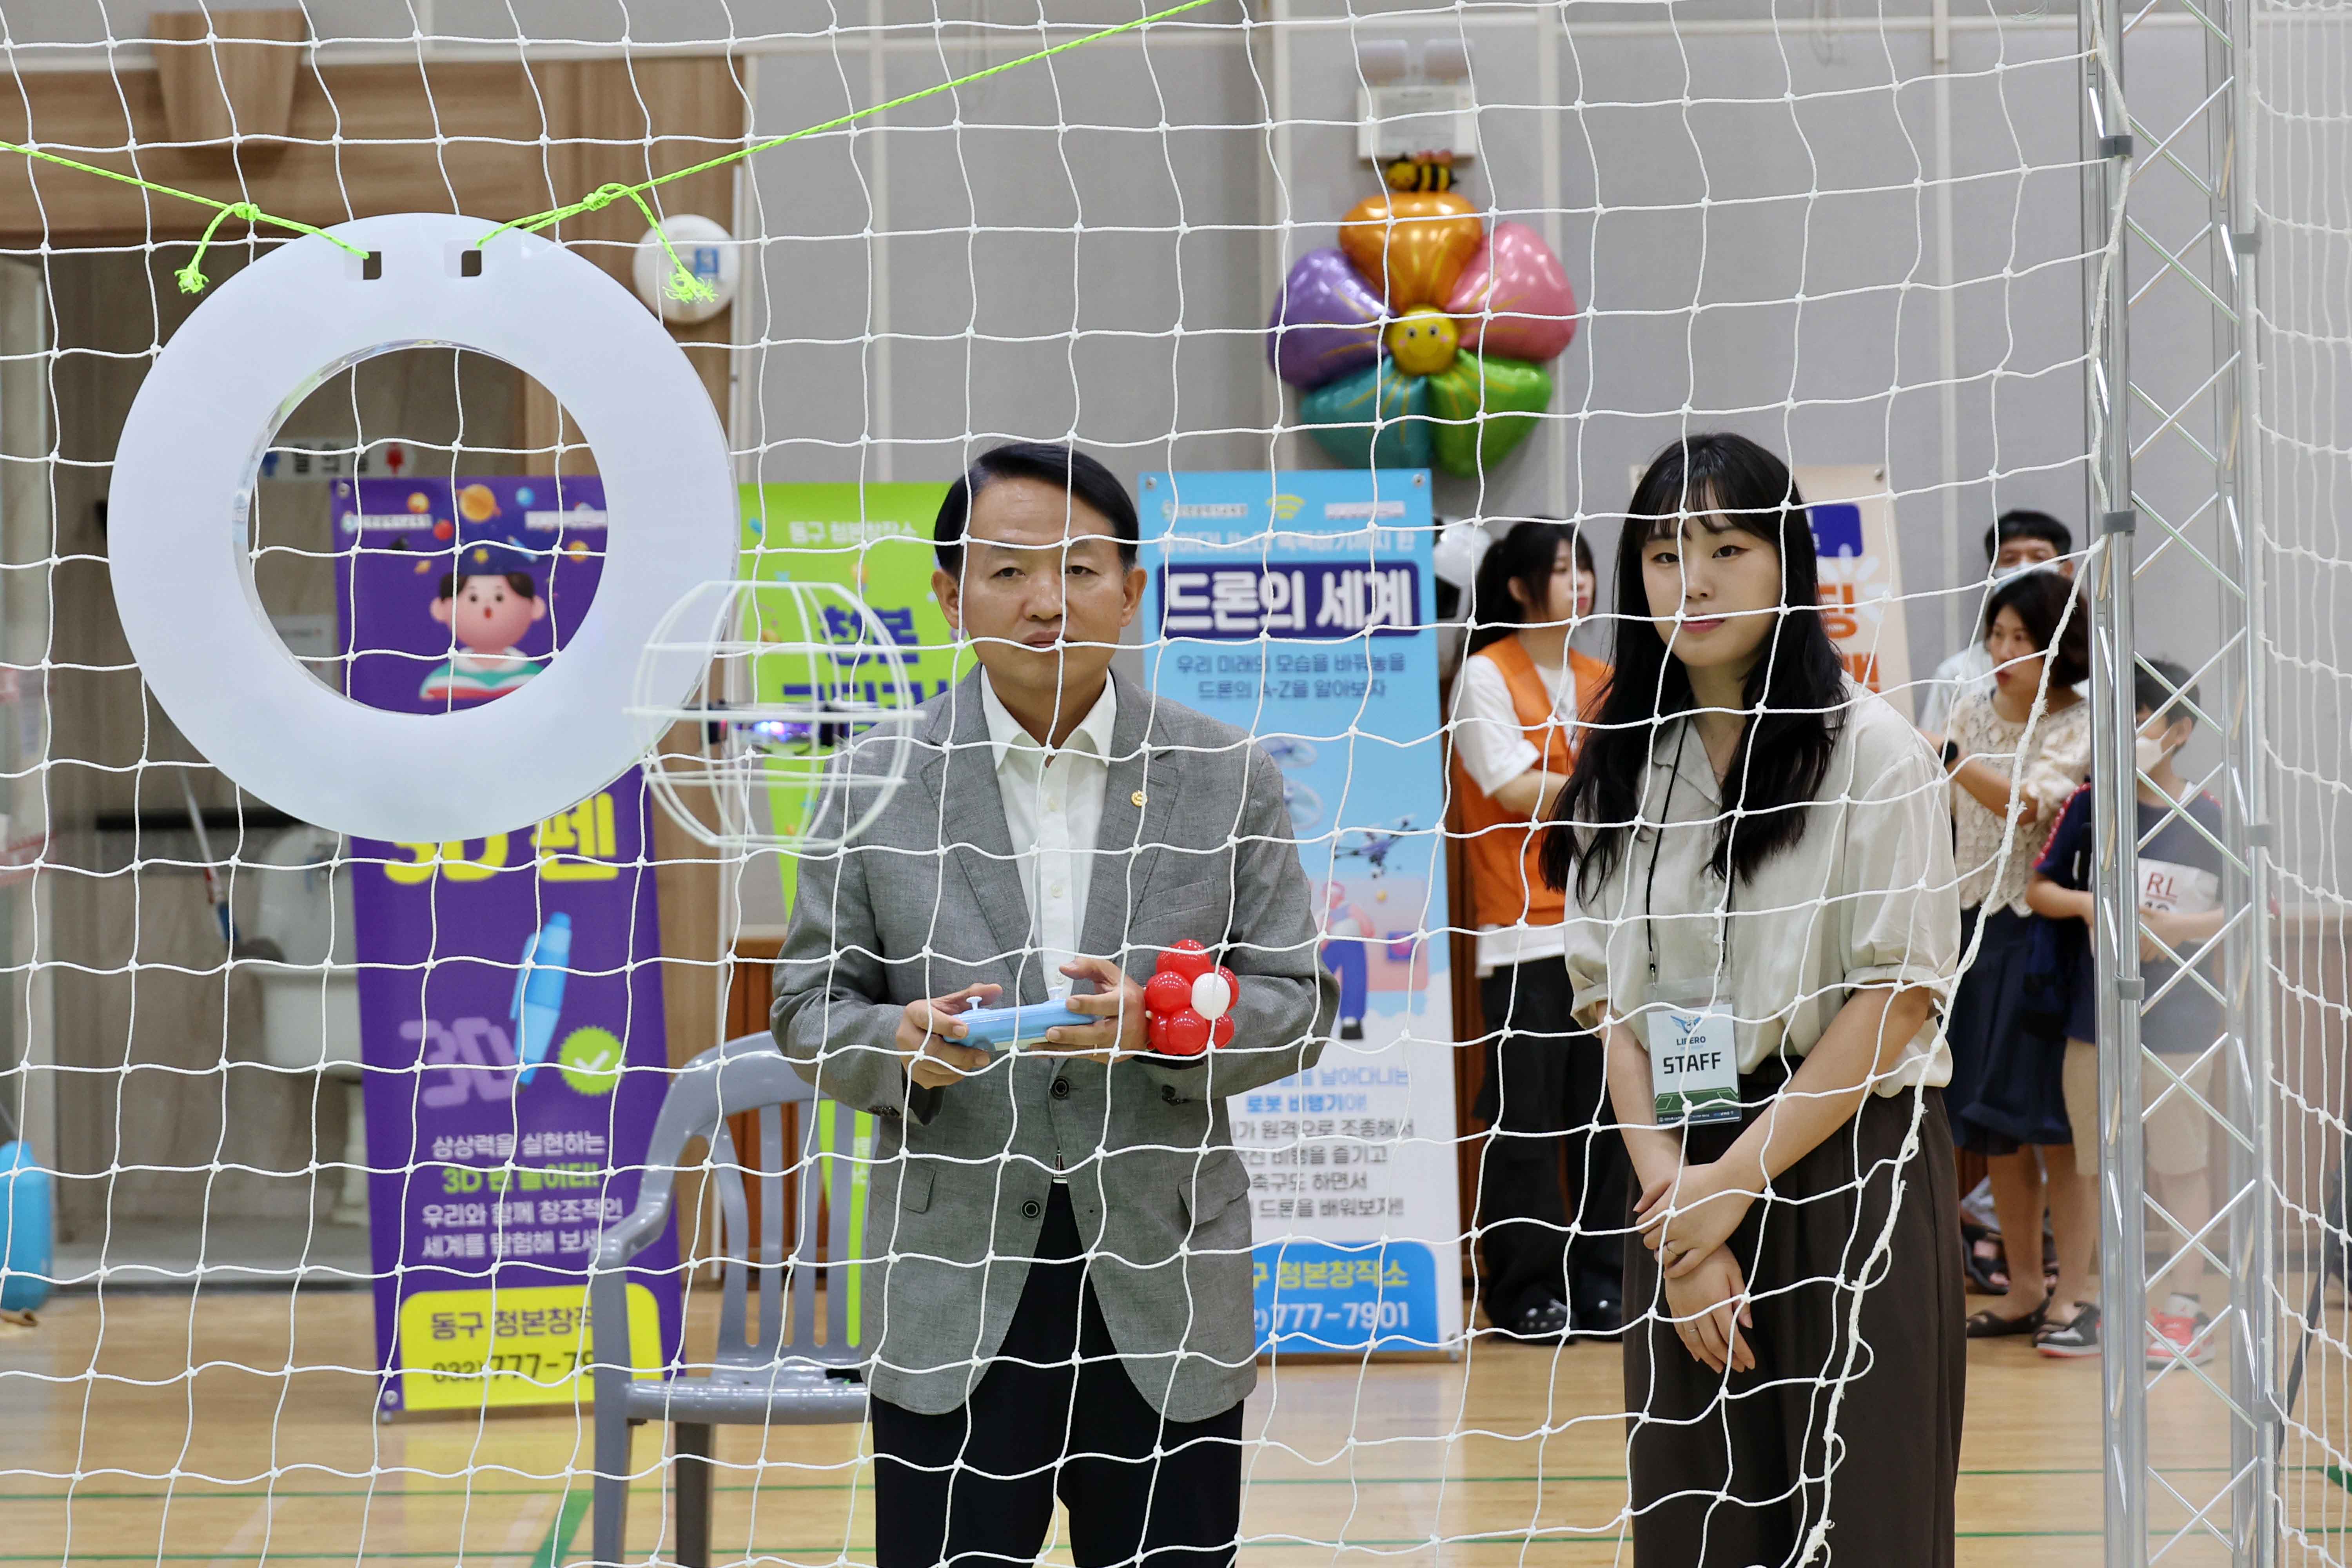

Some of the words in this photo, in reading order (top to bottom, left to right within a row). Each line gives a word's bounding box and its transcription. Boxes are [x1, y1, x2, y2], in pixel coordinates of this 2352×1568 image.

[1167, 569, 1306, 631] 드론의
[1316, 568, 1412, 630] 세계
[1177, 655, 1211, 674] 우리
[1218, 655, 1271, 673] 미래의
[1277, 654, 1328, 673] 모습을
[1199, 681, 1252, 700] 드론의
[1315, 680, 1387, 699] 알아보자
[530, 792, 619, 882] 펜
[1664, 1052, 1721, 1074] STAFF
[1262, 1120, 1333, 1138] 원격으로
[1341, 1118, 1414, 1136] 조종해서
[432, 1134, 514, 1160] 상상력을
[521, 1131, 605, 1158] 실현하는
[1333, 1145, 1387, 1164] 즐기고
[442, 1167, 482, 1194] 3D
[1252, 1173, 1306, 1191] 축구도
[1312, 1172, 1368, 1190] 하면서
[422, 1203, 486, 1228] 우리와
[491, 1201, 534, 1225] 함께
[539, 1198, 624, 1224] 창조적인
[1259, 1199, 1313, 1218] 드론을
[422, 1235, 486, 1259] 세계를
[431, 1311, 483, 1340] 동구
[432, 1350, 593, 1384] 032)777-79
